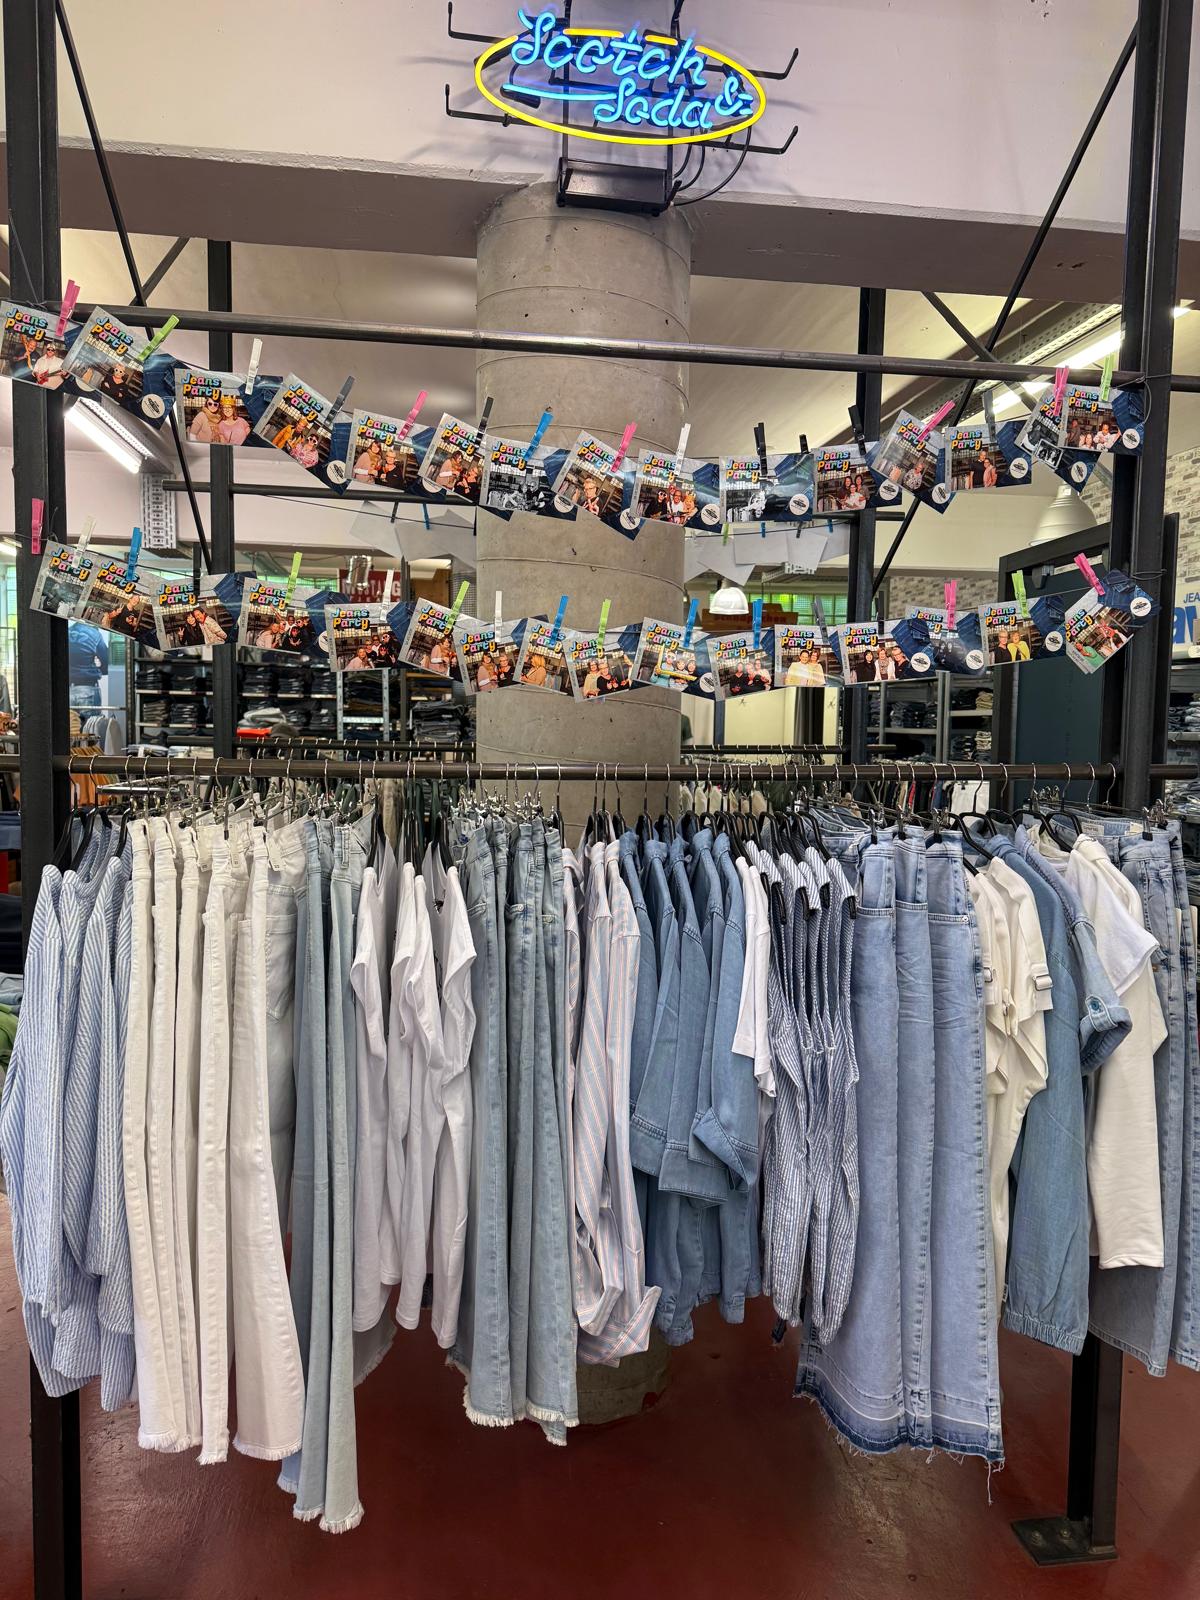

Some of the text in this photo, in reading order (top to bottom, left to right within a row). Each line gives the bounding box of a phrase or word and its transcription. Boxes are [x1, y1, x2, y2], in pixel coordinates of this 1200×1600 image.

[511, 9, 753, 116] Scotch &
[594, 77, 713, 128] Soda
[6, 307, 48, 328] Jeans
[5, 318, 45, 341] Party
[96, 316, 134, 345] Jeans
[91, 324, 128, 355] Party
[182, 372, 221, 386] Jeans
[183, 384, 221, 400] Party
[289, 383, 323, 411] Jeans
[1068, 387, 1099, 400] Jeans
[284, 390, 318, 421] Party
[1069, 397, 1098, 413] Party
[359, 415, 396, 433] Jeans
[358, 425, 394, 445] Party
[441, 429, 474, 455] Party
[950, 429, 982, 441] Jeans
[493, 442, 527, 456] Jeans
[583, 439, 615, 464] Jeans
[952, 440, 982, 451] Party
[491, 451, 527, 471] Party
[578, 446, 610, 472] Party
[817, 450, 850, 461] Jeans
[726, 459, 760, 471] Jeans
[818, 460, 851, 472] Party
[643, 464, 676, 483] Party
[726, 470, 760, 484] Party
[98, 569, 136, 594] Party
[157, 583, 195, 595] Jeans
[250, 583, 287, 597] Jeans
[159, 594, 197, 605] Party
[250, 592, 286, 610] Party
[332, 608, 369, 618] Jeans
[911, 609, 943, 621] Jeans
[984, 606, 1015, 617] Jeans
[333, 618, 370, 630] Party
[985, 616, 1016, 628] Party
[1066, 615, 1094, 641] Party
[460, 630, 495, 644] Jeans
[648, 623, 681, 639] Jeans
[780, 627, 814, 638] Jeans
[843, 626, 876, 637] Jeans
[462, 642, 497, 654] Party
[646, 632, 679, 650] Party
[713, 638, 746, 650] Jeans
[781, 637, 814, 651] Party
[845, 635, 878, 647] Party
[715, 648, 747, 659] Party
